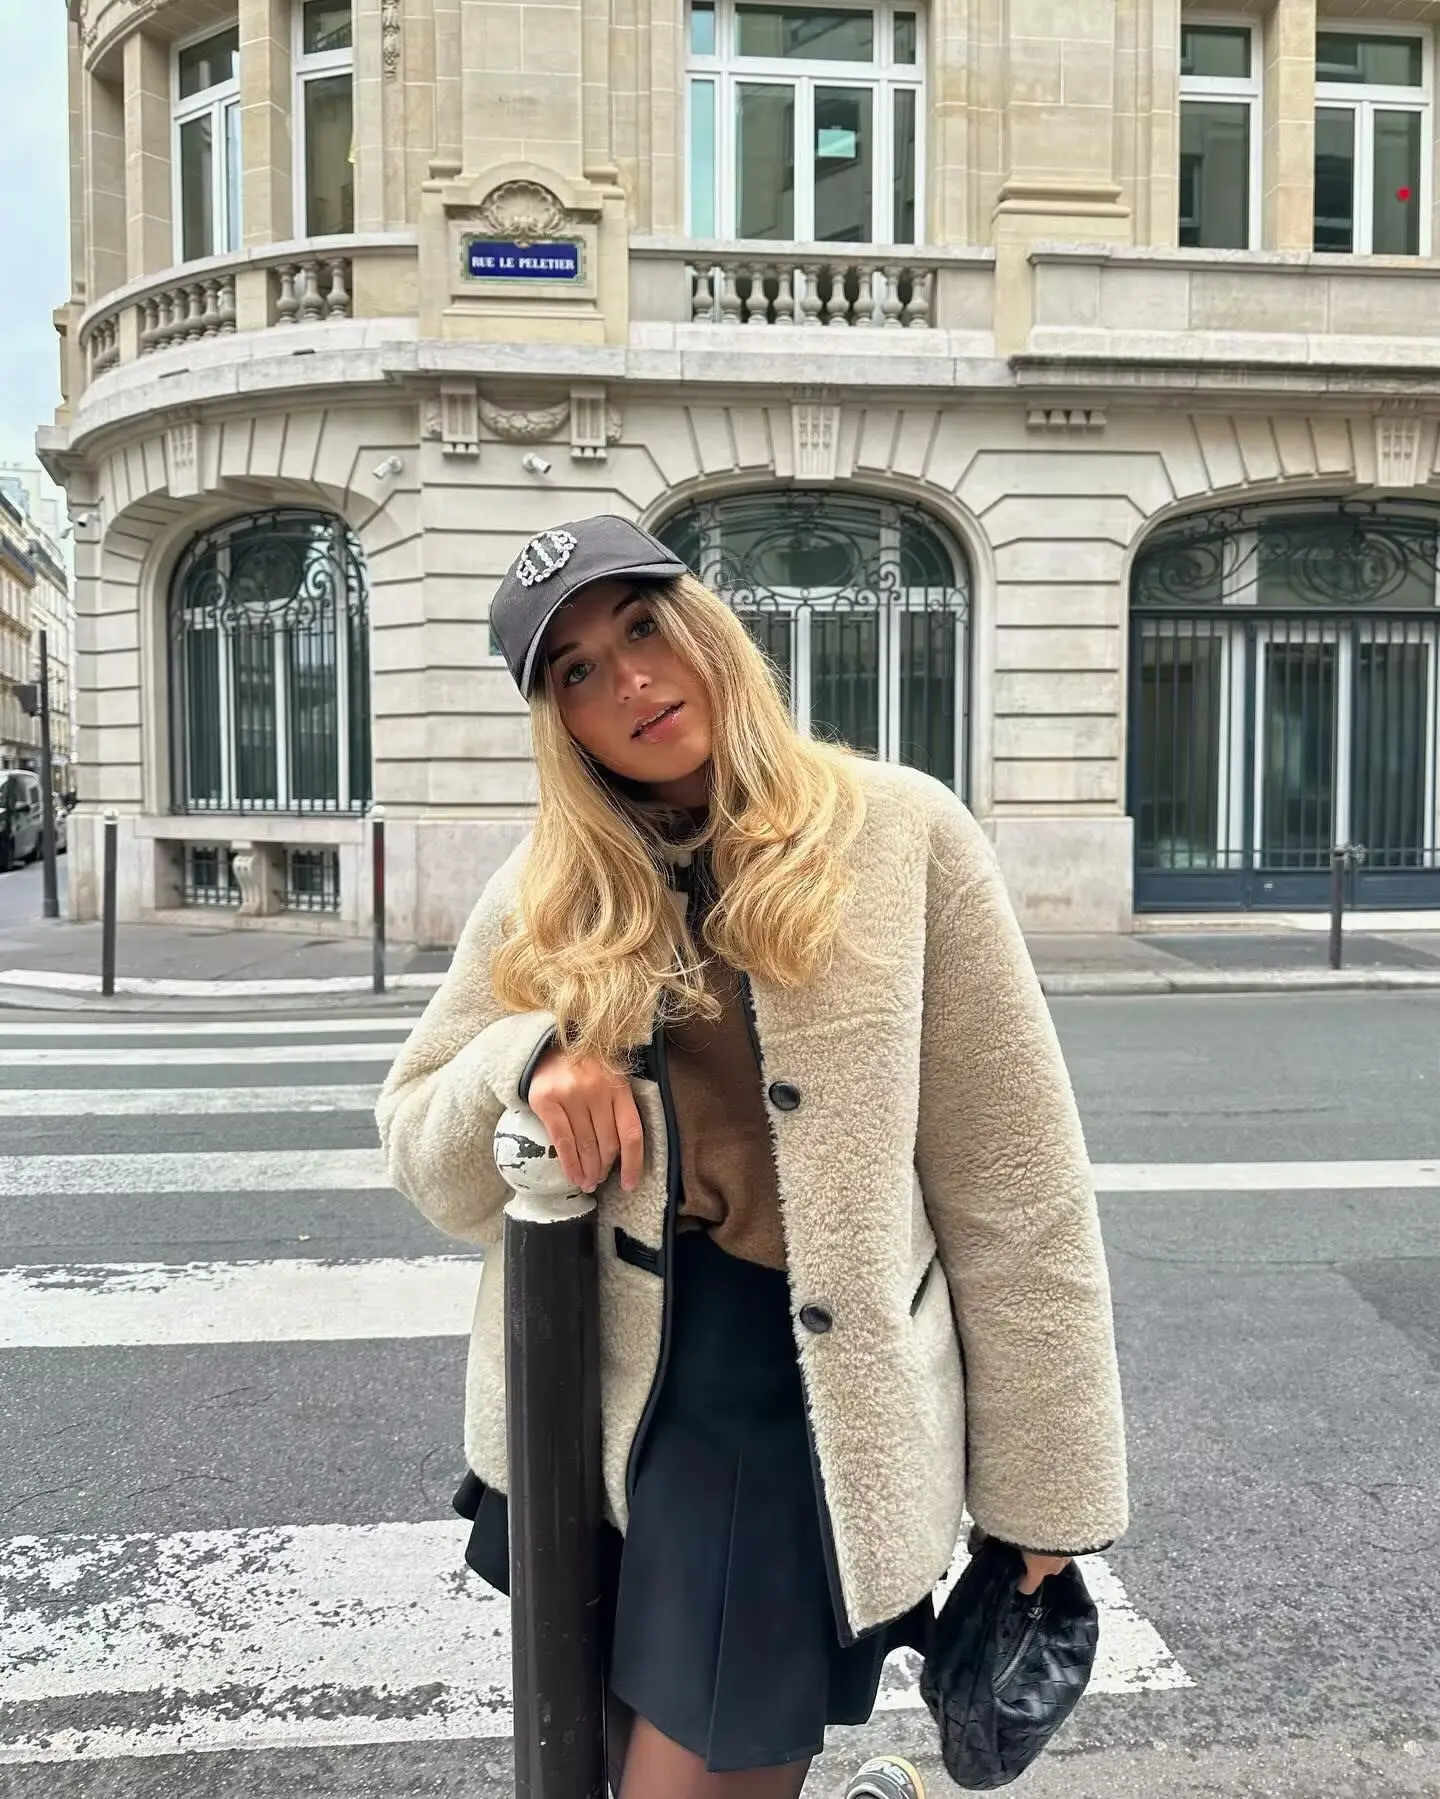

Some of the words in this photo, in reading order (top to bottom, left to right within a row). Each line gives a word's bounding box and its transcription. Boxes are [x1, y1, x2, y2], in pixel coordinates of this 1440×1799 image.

[471, 256, 496, 268] RUE
[499, 257, 515, 269] LE
[518, 257, 575, 270] PELETIER
